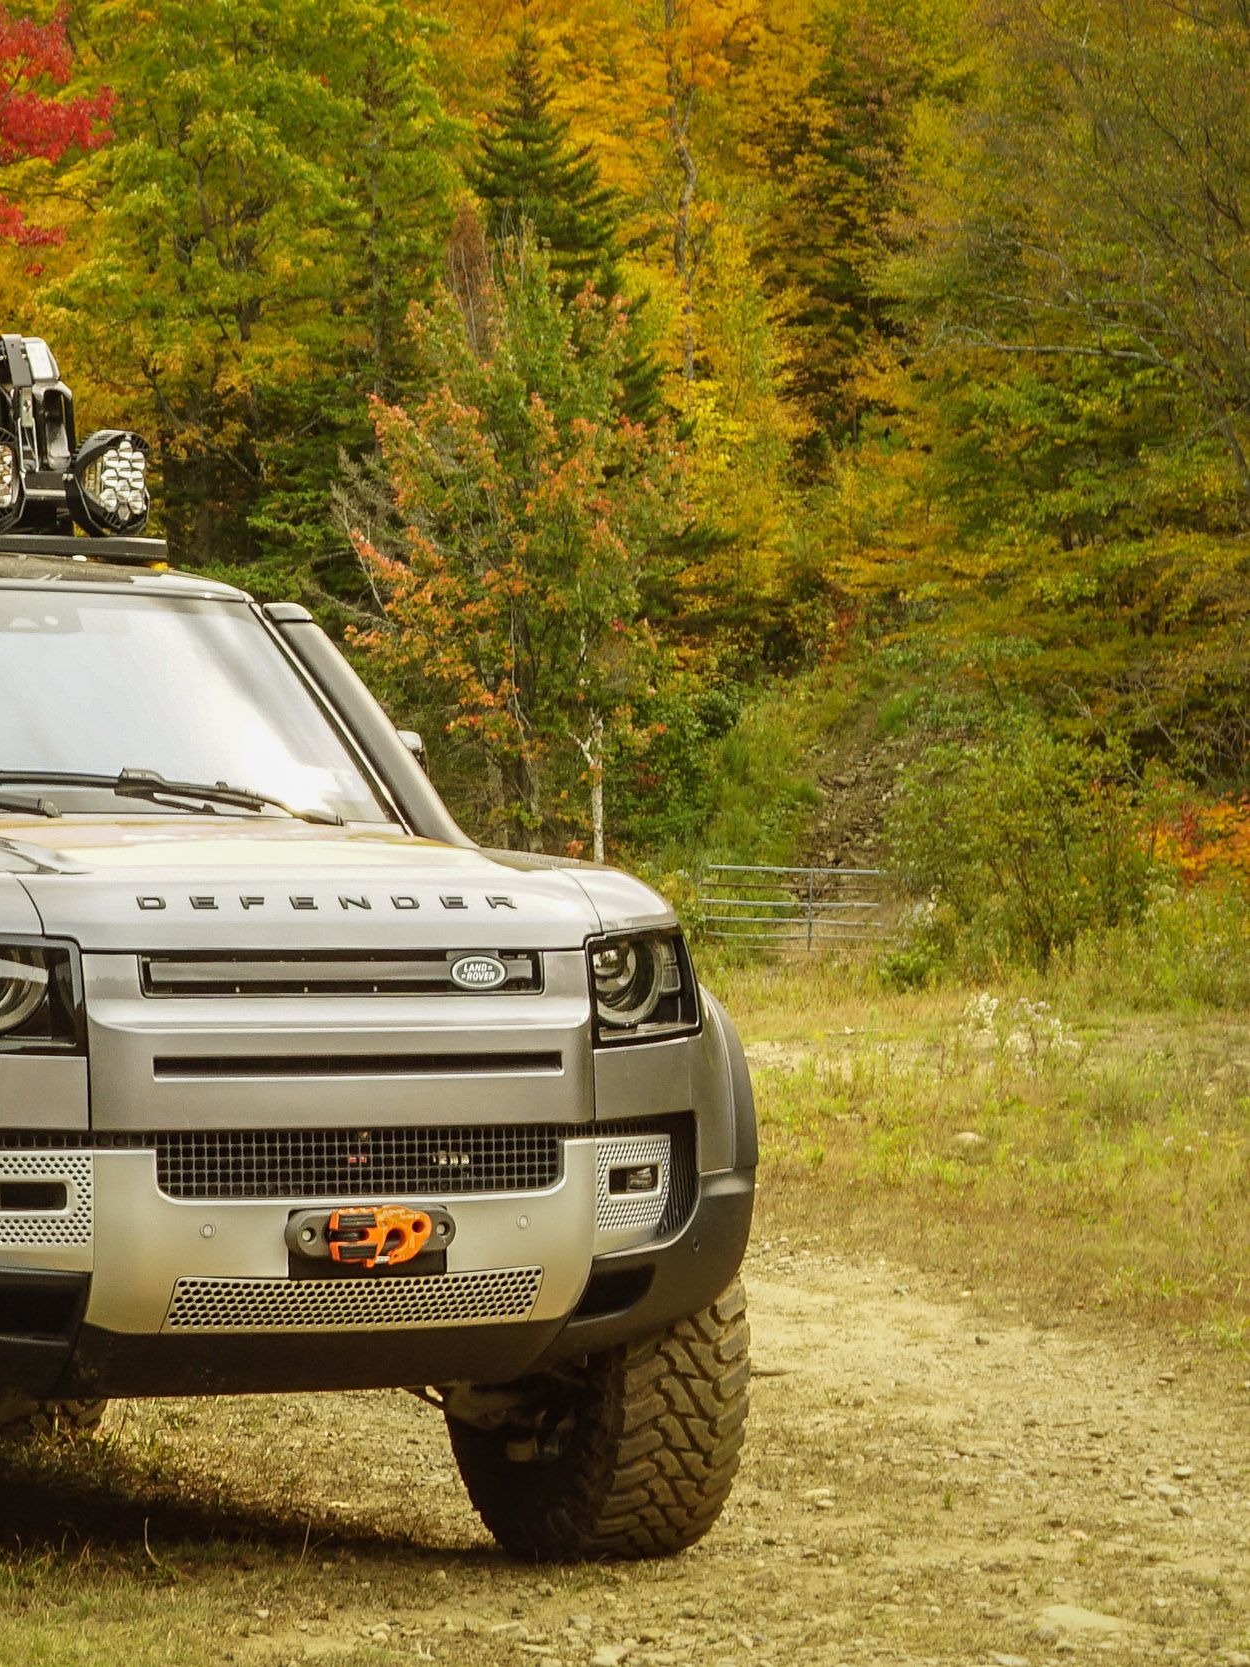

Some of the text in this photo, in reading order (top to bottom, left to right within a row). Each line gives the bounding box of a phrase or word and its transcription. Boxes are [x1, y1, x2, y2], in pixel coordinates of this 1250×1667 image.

[136, 895, 518, 911] DEFENDER
[463, 963, 488, 973] LAND
[466, 971, 496, 981] ROVER
